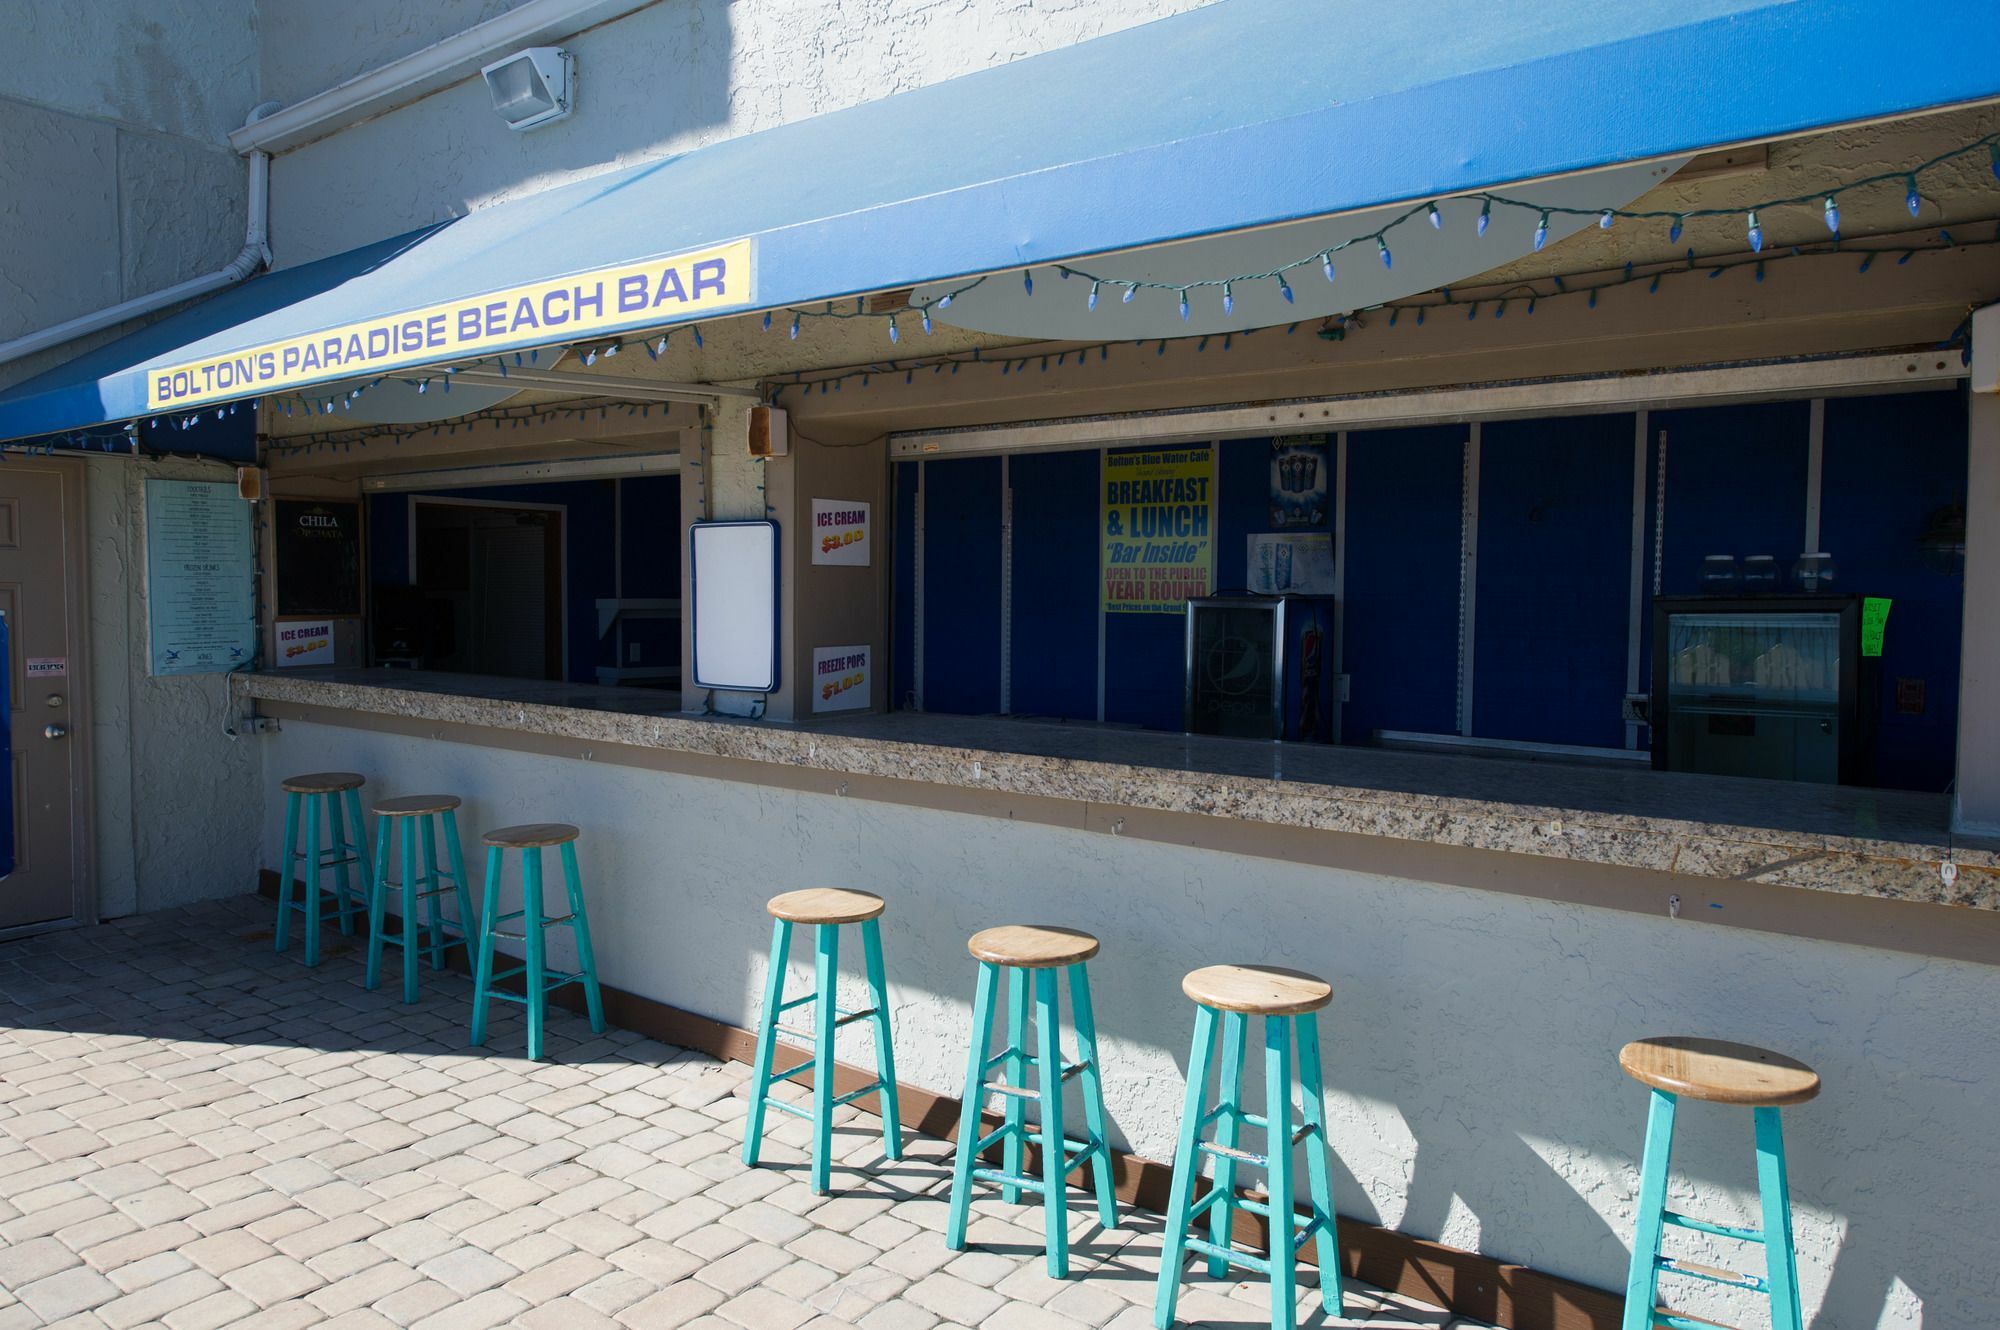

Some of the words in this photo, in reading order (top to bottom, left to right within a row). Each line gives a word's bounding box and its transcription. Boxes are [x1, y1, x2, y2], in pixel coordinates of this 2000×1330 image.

[158, 352, 275, 400] BOLTON'S
[283, 313, 446, 375] PARADISE
[458, 282, 603, 342] BEACH
[618, 258, 726, 313] BAR
[1142, 454, 1161, 466] Blue
[1162, 452, 1187, 464] Water
[1107, 477, 1208, 505] BREAKFAST
[299, 516, 338, 527] CHILA
[817, 512, 833, 527] ICE
[834, 510, 865, 526] CREAM
[1107, 509, 1124, 537] &
[1130, 505, 1208, 538] LUNCH
[1106, 542, 1141, 563] "Bar
[1142, 541, 1207, 563] Inside"
[1106, 567, 1132, 580] OPEN
[1134, 567, 1146, 580] TO
[1150, 567, 1167, 580] THE
[1170, 567, 1207, 580] PUBLIC
[1106, 581, 1145, 600] YEAR
[1150, 581, 1207, 600] ROUND
[281, 630, 296, 641] ICE
[297, 626, 329, 639] CREAM
[818, 656, 845, 675] FREEZIE
[846, 653, 865, 669] POPS
